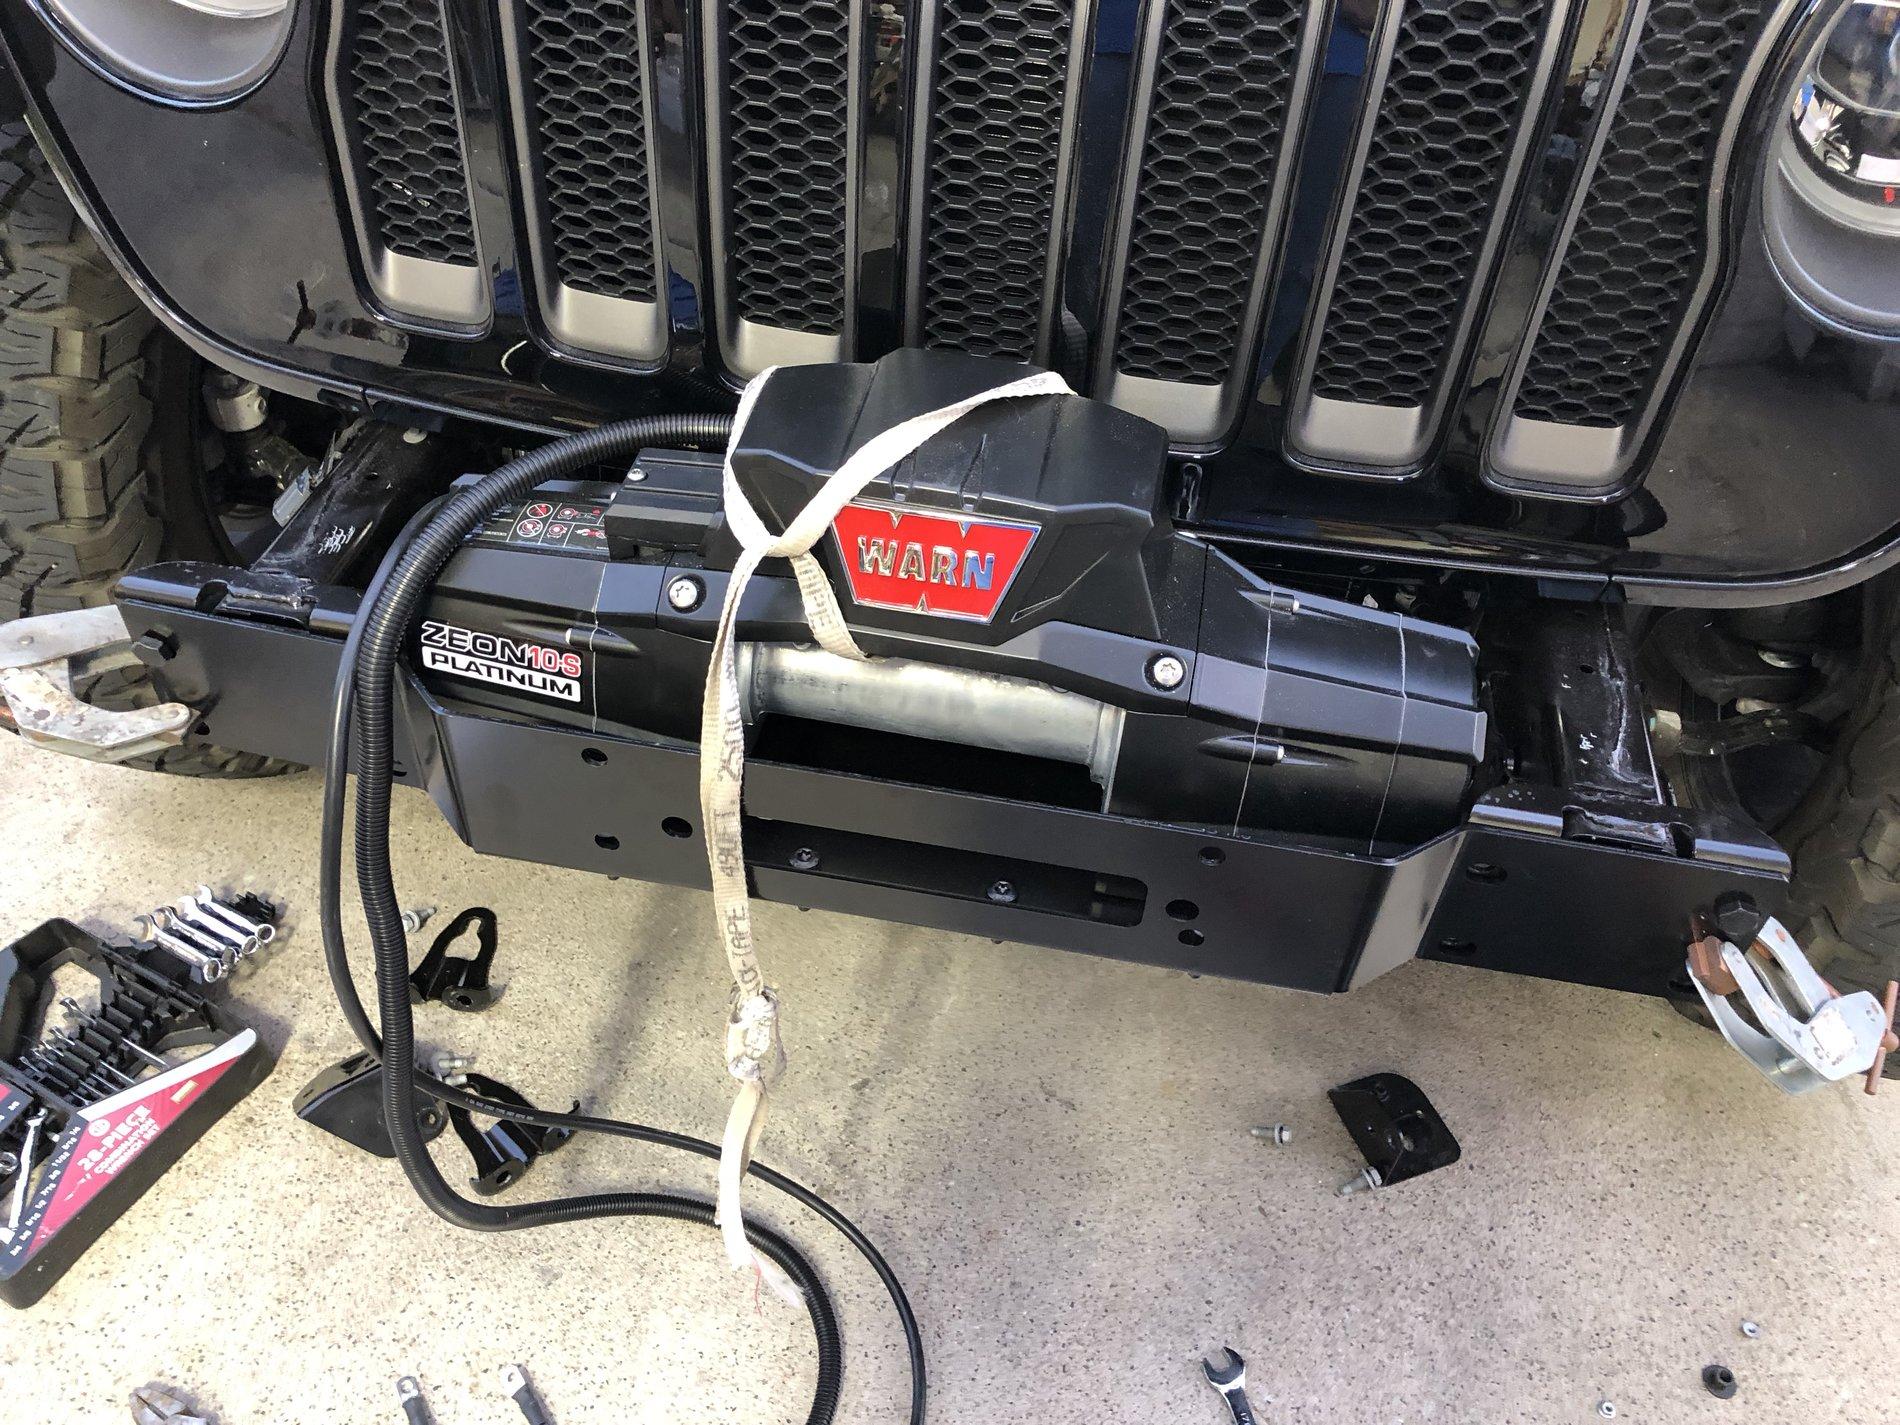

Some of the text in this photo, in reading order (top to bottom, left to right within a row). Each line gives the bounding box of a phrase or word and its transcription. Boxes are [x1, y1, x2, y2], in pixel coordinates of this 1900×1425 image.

[857, 535, 995, 591] WARN
[431, 652, 572, 696] PLATINUM
[77, 1104, 151, 1171] 28-PIECE
